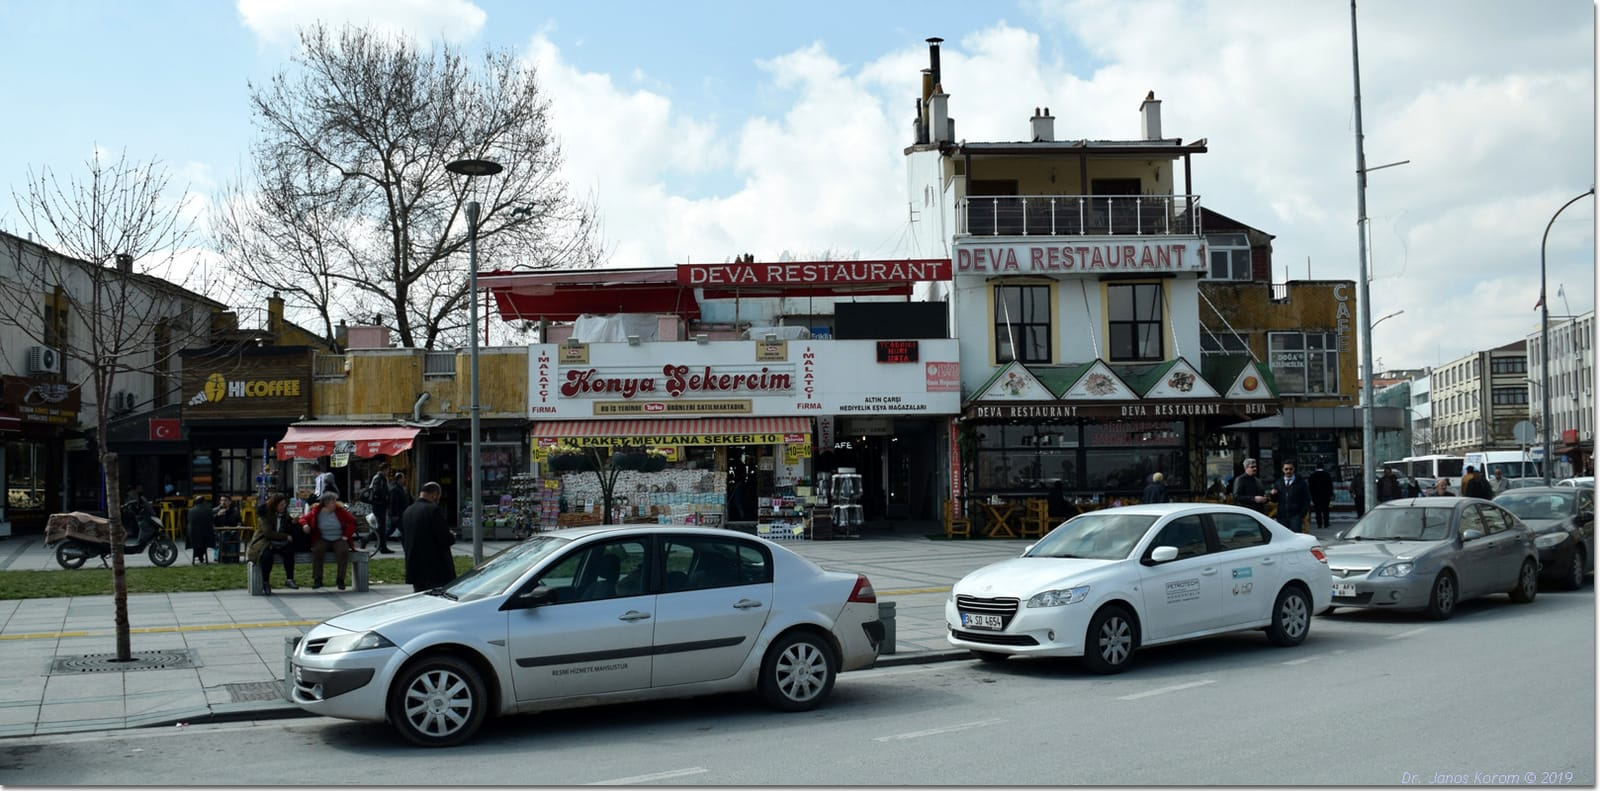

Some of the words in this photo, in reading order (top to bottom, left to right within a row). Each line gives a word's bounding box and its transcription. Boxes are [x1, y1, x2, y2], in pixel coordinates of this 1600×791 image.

[957, 247, 1019, 272] DEVA
[1030, 244, 1186, 271] RESTAURANT
[690, 266, 758, 284] DEVA
[767, 262, 943, 283] RESTAURANT
[1333, 284, 1351, 352] CAFE
[561, 368, 656, 399] Konya
[663, 364, 792, 398] Şekercim
[978, 406, 1002, 417] DEVA
[1011, 406, 1077, 417] RESTAURANT
[1121, 406, 1146, 416] DEVA
[1155, 404, 1220, 415] RESTAURANT
[1245, 403, 1266, 414] DEVA
[582, 437, 628, 446] PAKET
[632, 436, 700, 445] MEVLANA
[834, 441, 853, 450] AFE
[965, 614, 973, 624] 34
